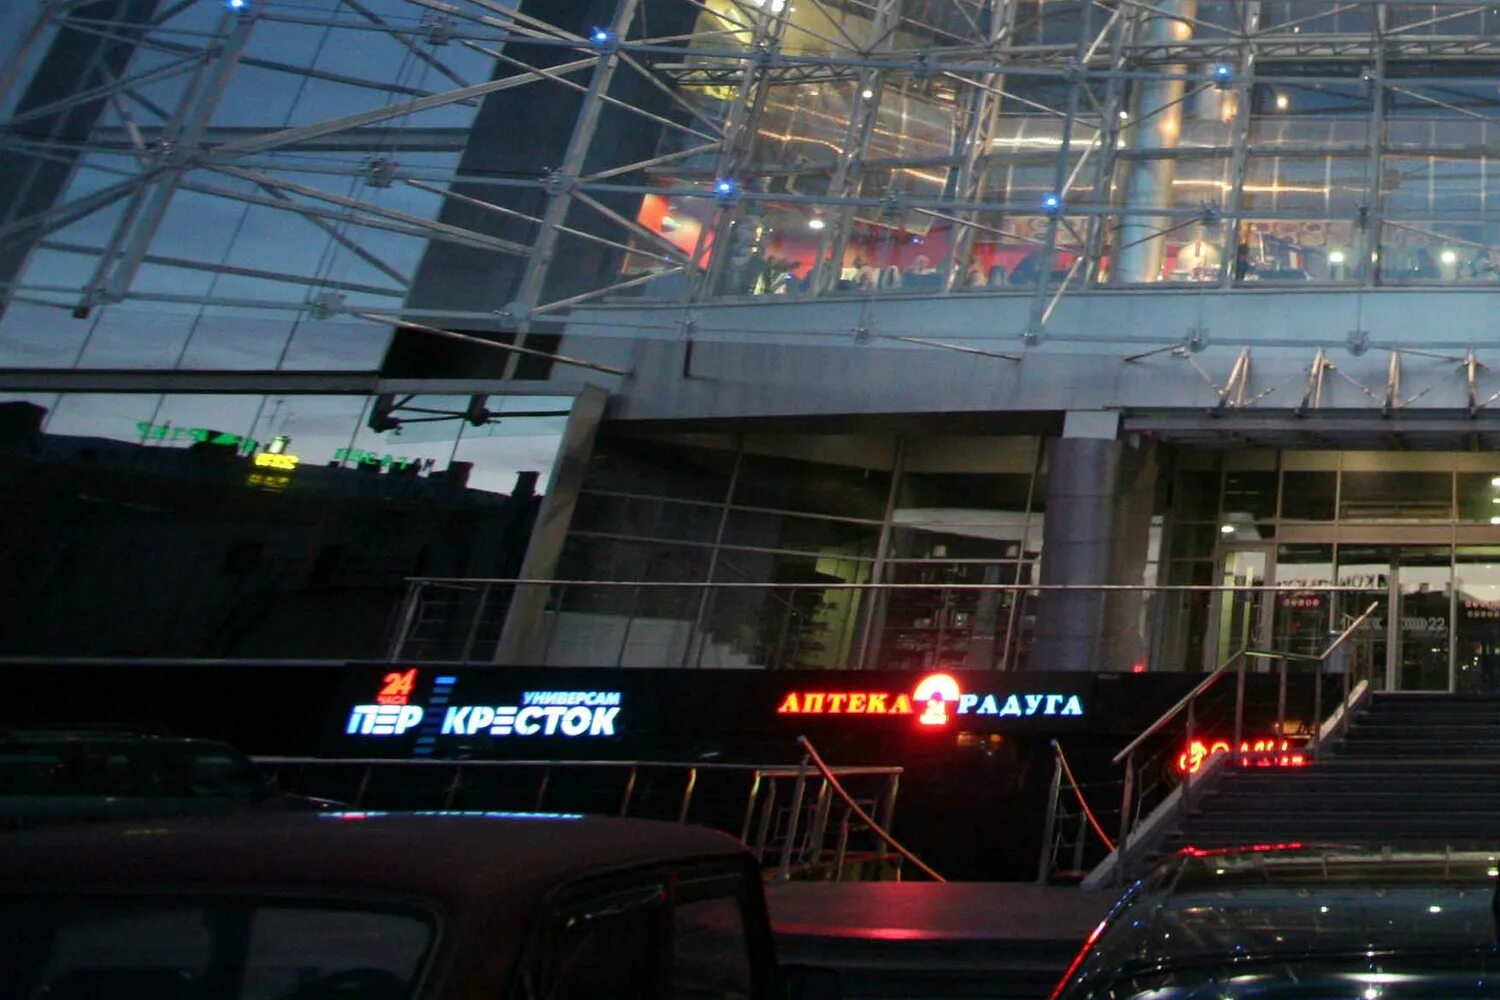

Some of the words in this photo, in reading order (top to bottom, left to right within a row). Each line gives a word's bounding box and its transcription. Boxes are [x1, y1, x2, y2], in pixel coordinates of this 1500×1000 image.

[380, 668, 417, 695] 24
[522, 691, 622, 706] УНИВЕРСАМ
[777, 691, 915, 714] АПТЕКА
[956, 692, 1083, 716] РАДУГА
